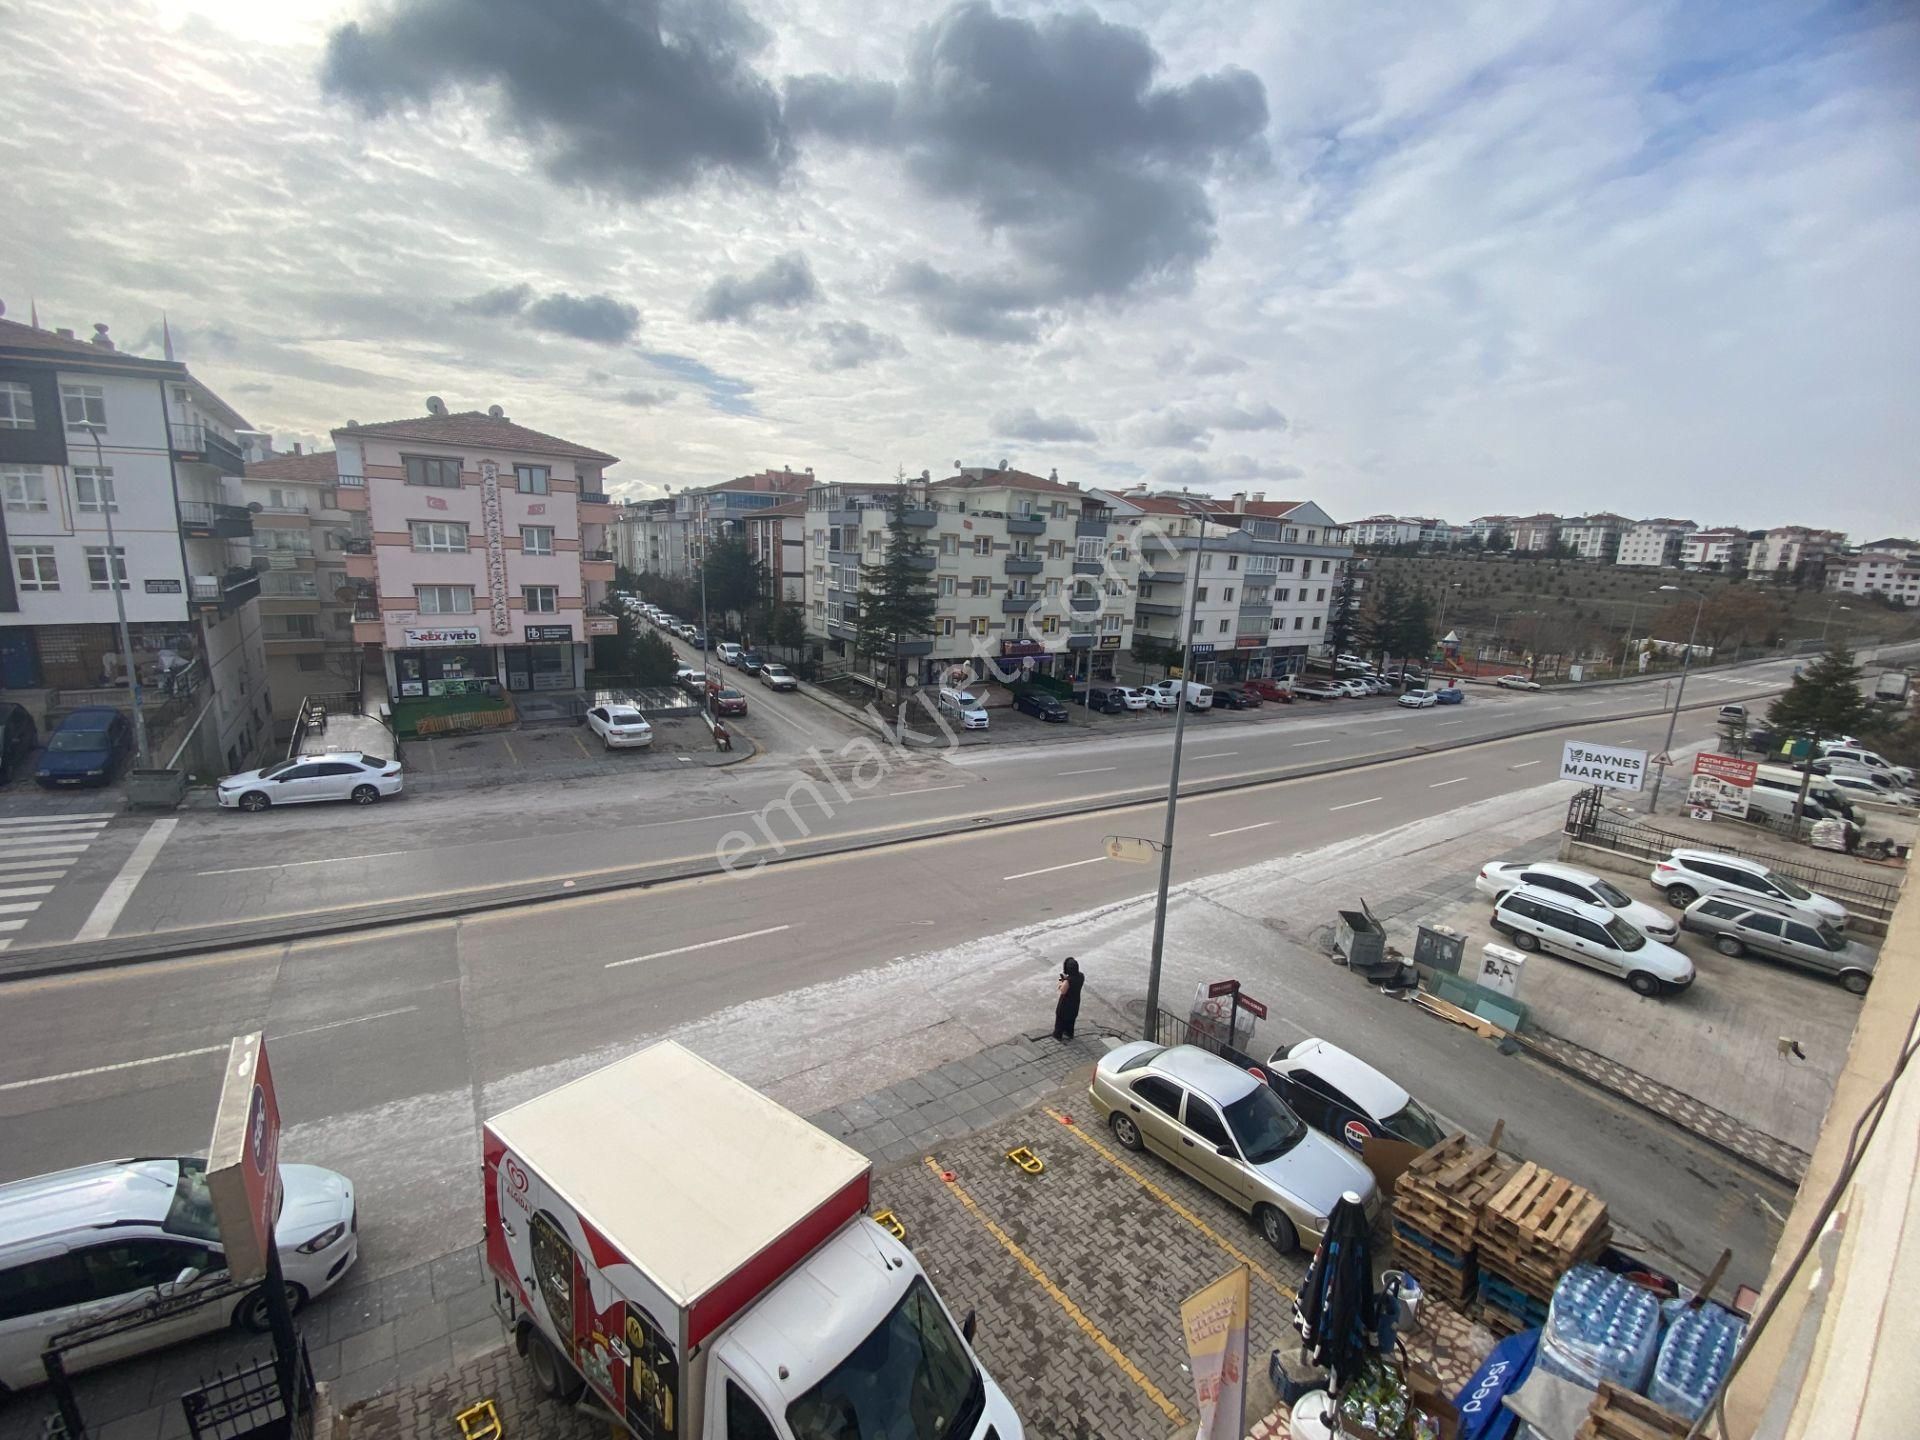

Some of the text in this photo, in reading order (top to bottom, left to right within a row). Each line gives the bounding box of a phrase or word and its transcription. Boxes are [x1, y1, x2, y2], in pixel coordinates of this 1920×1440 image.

[420, 630, 477, 641] REX VETO
[1584, 752, 1641, 769] BAYNES
[1564, 763, 1639, 785] MARKET
[1462, 1360, 1510, 1412] pepsi
